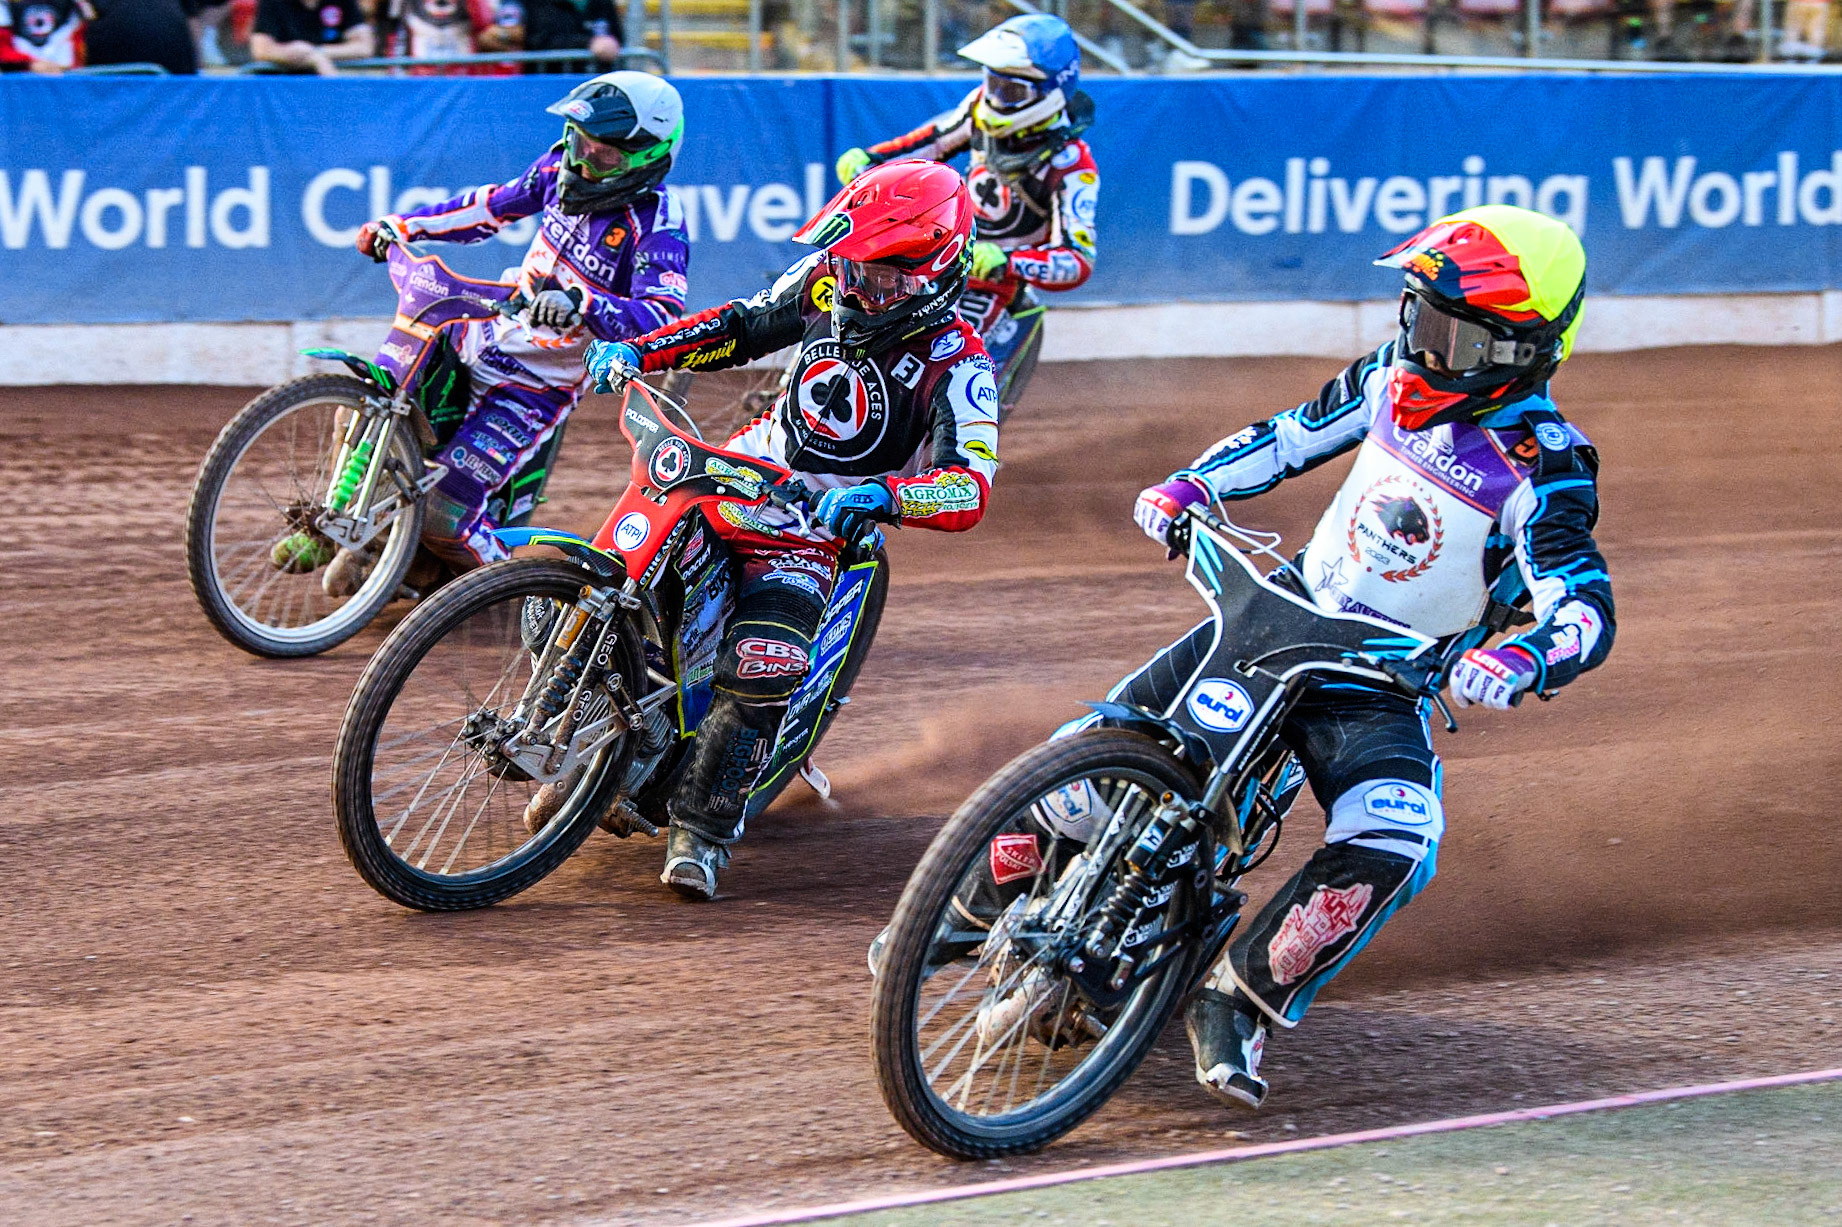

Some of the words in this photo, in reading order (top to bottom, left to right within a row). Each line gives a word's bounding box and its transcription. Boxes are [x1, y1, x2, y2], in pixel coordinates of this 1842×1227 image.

[1, 166, 271, 250] World
[1169, 156, 1588, 236] Delivering
[1612, 151, 1842, 230] World
[541, 214, 616, 282] rendon
[605, 227, 626, 247] 3
[804, 345, 840, 365] BELLE
[866, 382, 883, 421] ACES
[976, 386, 998, 404] ATP
[1392, 425, 1484, 492] Crendon
[1422, 458, 1476, 498] ENGINEERING
[904, 486, 972, 500] AGROMIX
[620, 522, 643, 541] ATPI
[1356, 522, 1419, 566] PANTHERS
[740, 640, 806, 662] CBS
[741, 660, 805, 675] BINS
